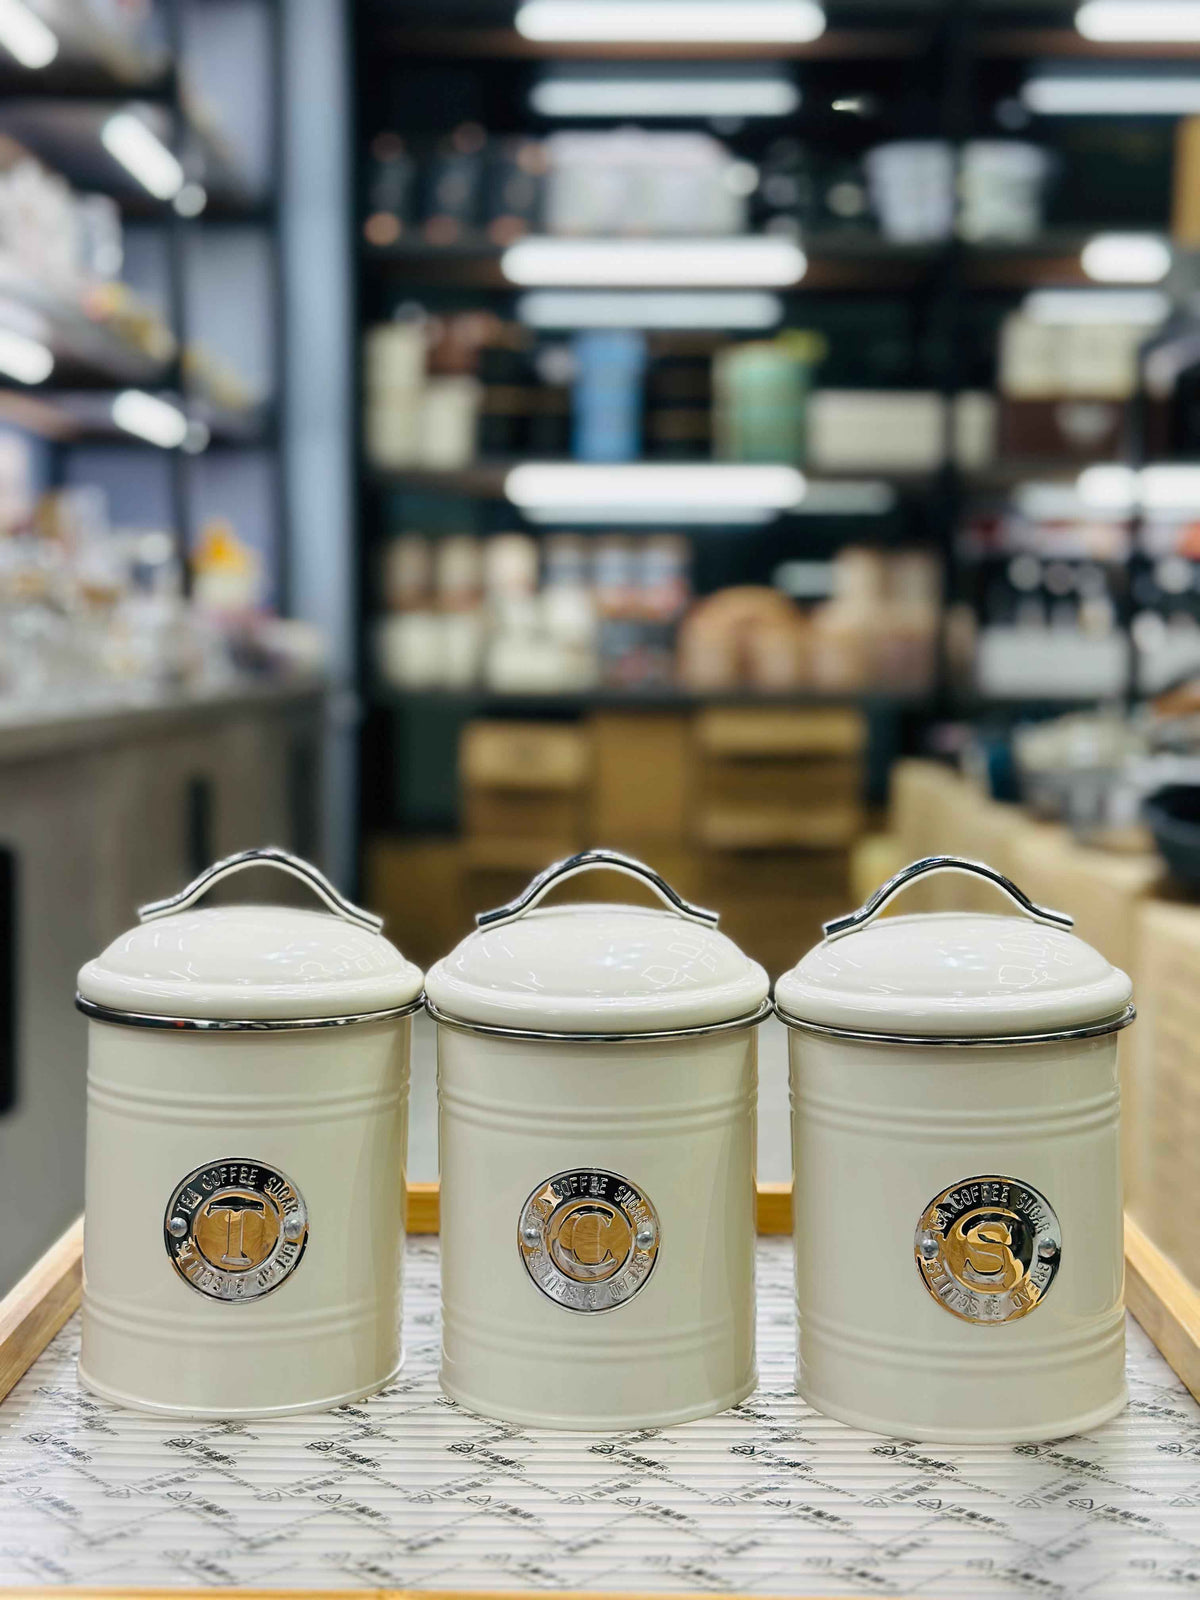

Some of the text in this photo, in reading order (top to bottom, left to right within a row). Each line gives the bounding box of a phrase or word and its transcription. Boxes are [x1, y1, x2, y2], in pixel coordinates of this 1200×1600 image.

[176, 1166, 299, 1215] TEA COFFEE SUGAR
[550, 1174, 609, 1198] COFFEE
[613, 1184, 650, 1225] SUGAR
[950, 1184, 1011, 1210] COFFEE
[1015, 1192, 1052, 1233] SUGAR
[204, 1196, 266, 1267] T
[552, 1204, 618, 1279] C
[960, 1211, 1013, 1287] S
[175, 1238, 299, 1295] BREAD BISCUITS
[1010, 1262, 1051, 1308] BREAD
